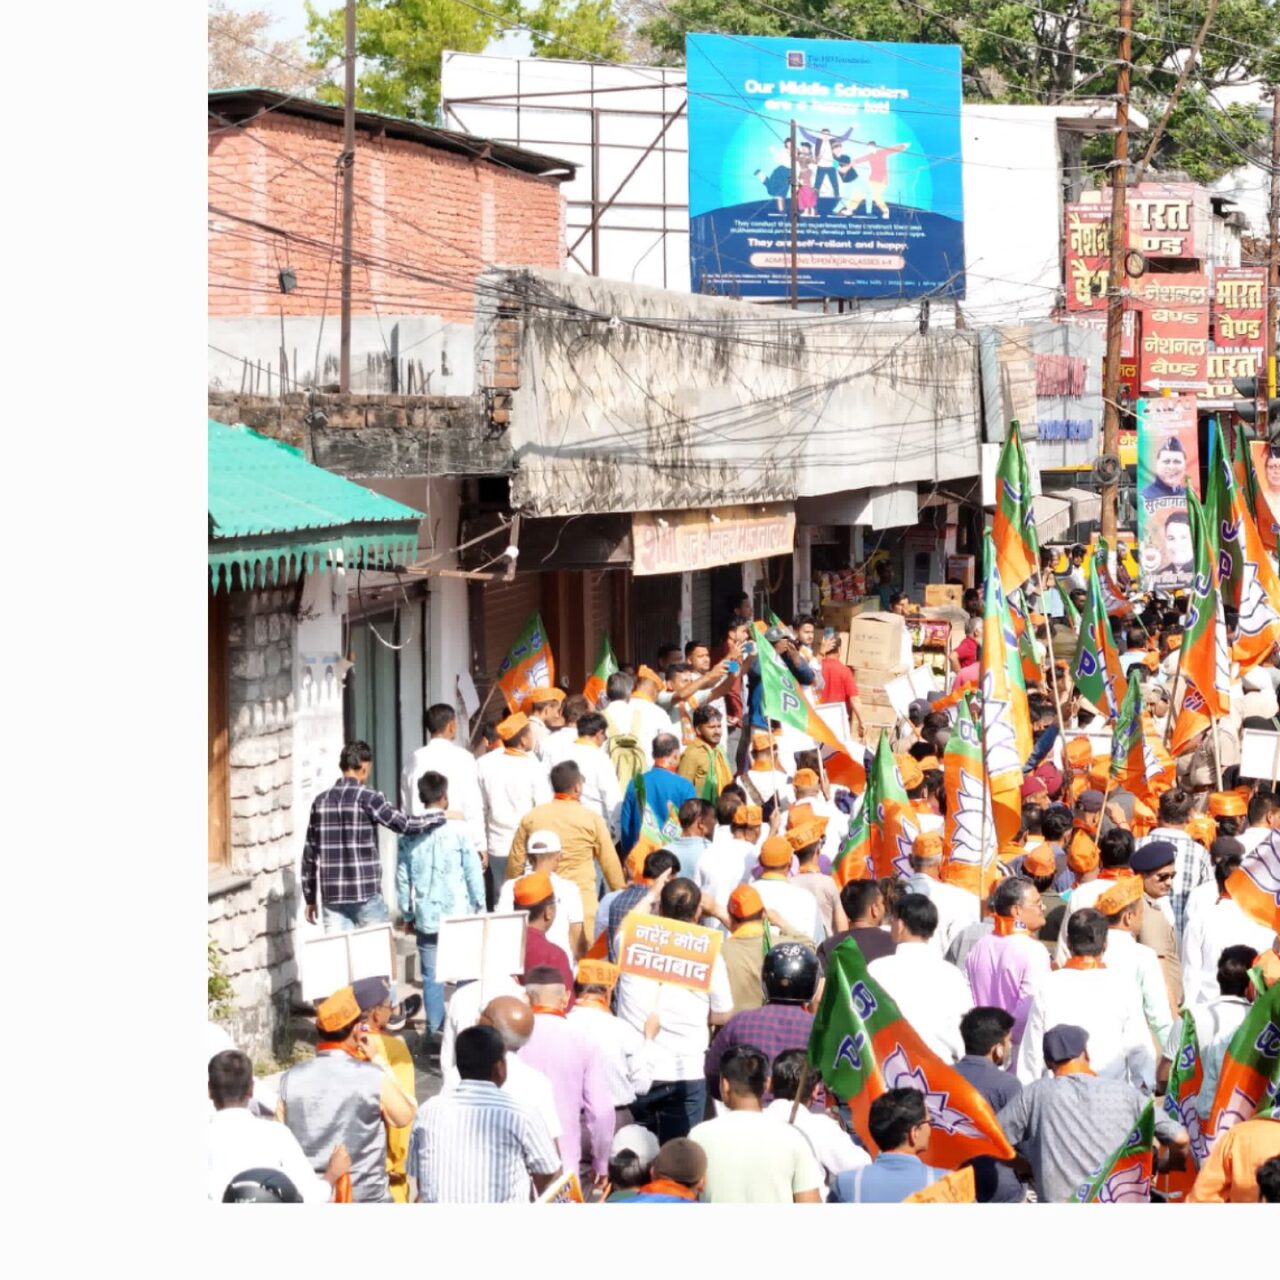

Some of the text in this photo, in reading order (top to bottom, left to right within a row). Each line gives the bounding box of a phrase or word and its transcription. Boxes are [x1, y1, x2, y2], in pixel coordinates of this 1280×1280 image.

[745, 80, 909, 99] Our Middle Schoolers
[764, 100, 791, 111] are
[748, 238, 772, 250] They
[855, 240, 873, 249] and
[1216, 280, 1264, 308] भारत
[635, 923, 710, 954] नरेंद्र मोदी
[626, 943, 710, 982] जिंदाबाद
